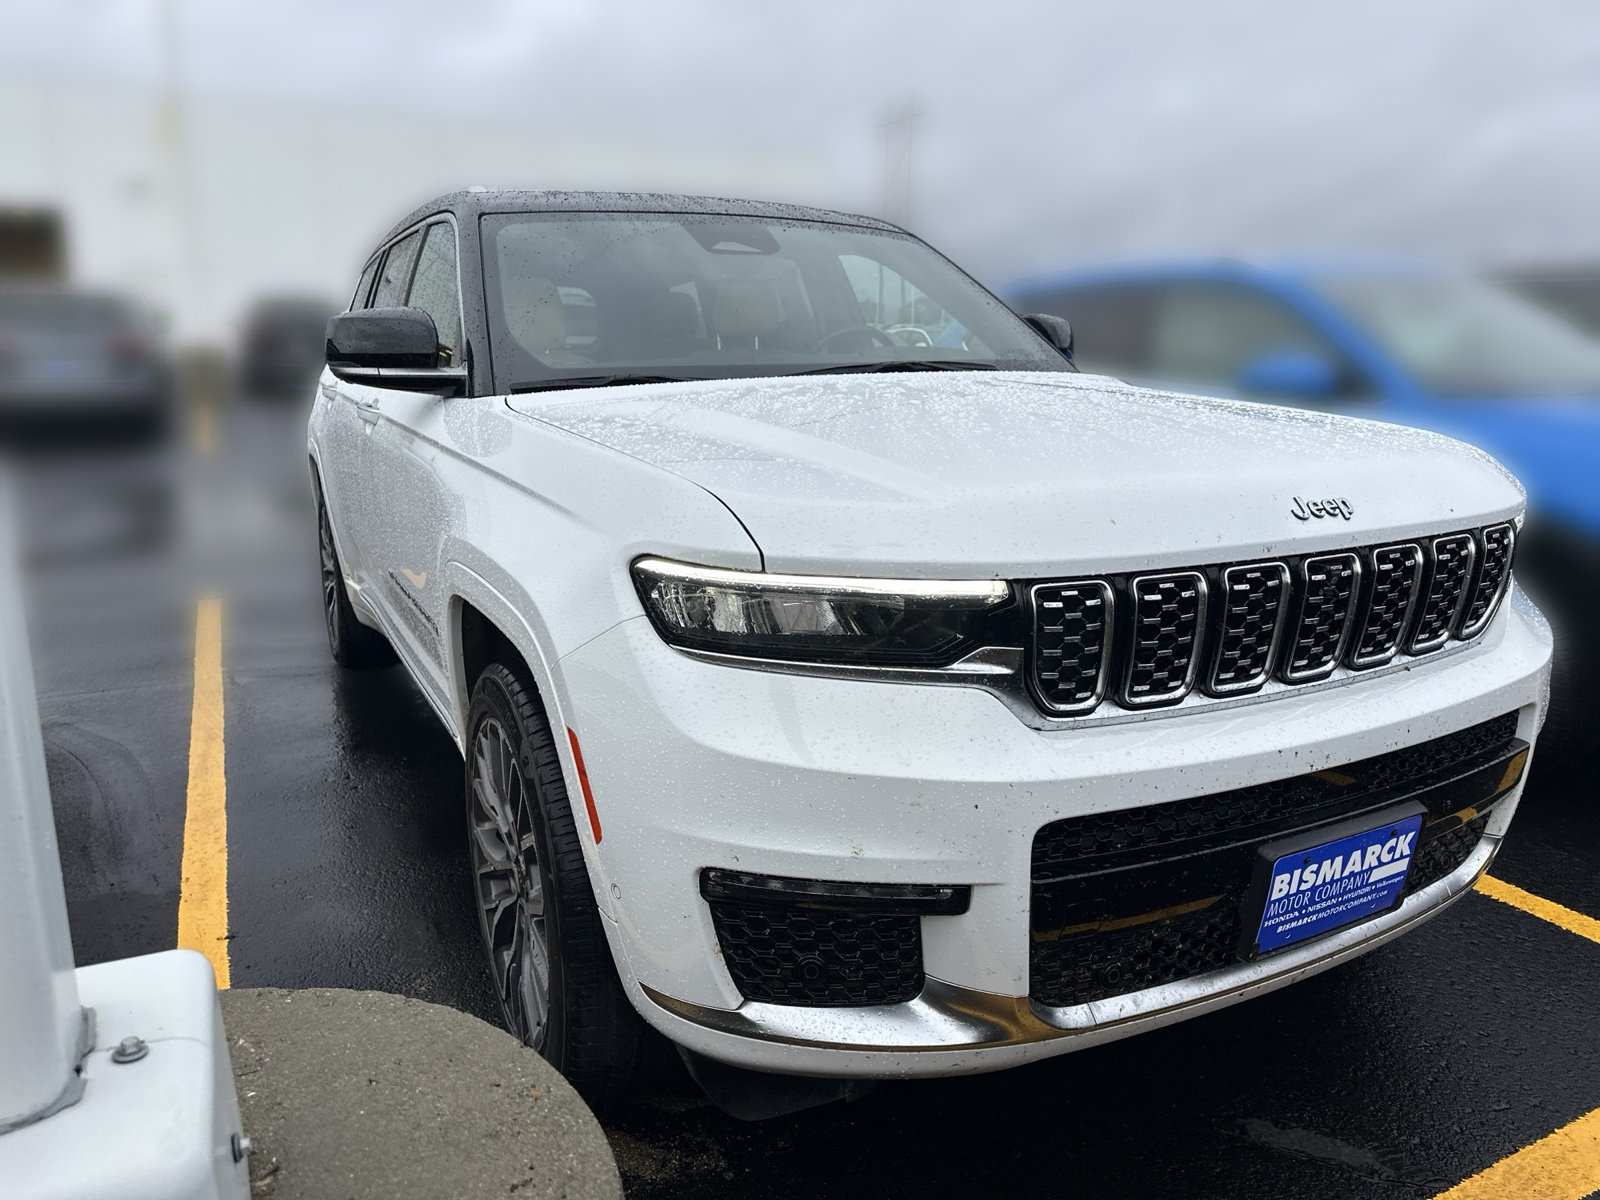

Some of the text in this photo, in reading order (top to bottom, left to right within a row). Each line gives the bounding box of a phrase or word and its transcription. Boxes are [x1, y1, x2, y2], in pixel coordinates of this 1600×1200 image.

[1291, 496, 1354, 521] Jeep
[1271, 831, 1416, 901] BISMARCK
[1264, 910, 1300, 928] HONDA
[1307, 897, 1338, 913] NISSAN
[1343, 886, 1372, 901] HYUNDAI
[1267, 871, 1371, 918] MOTOR COMPANY
